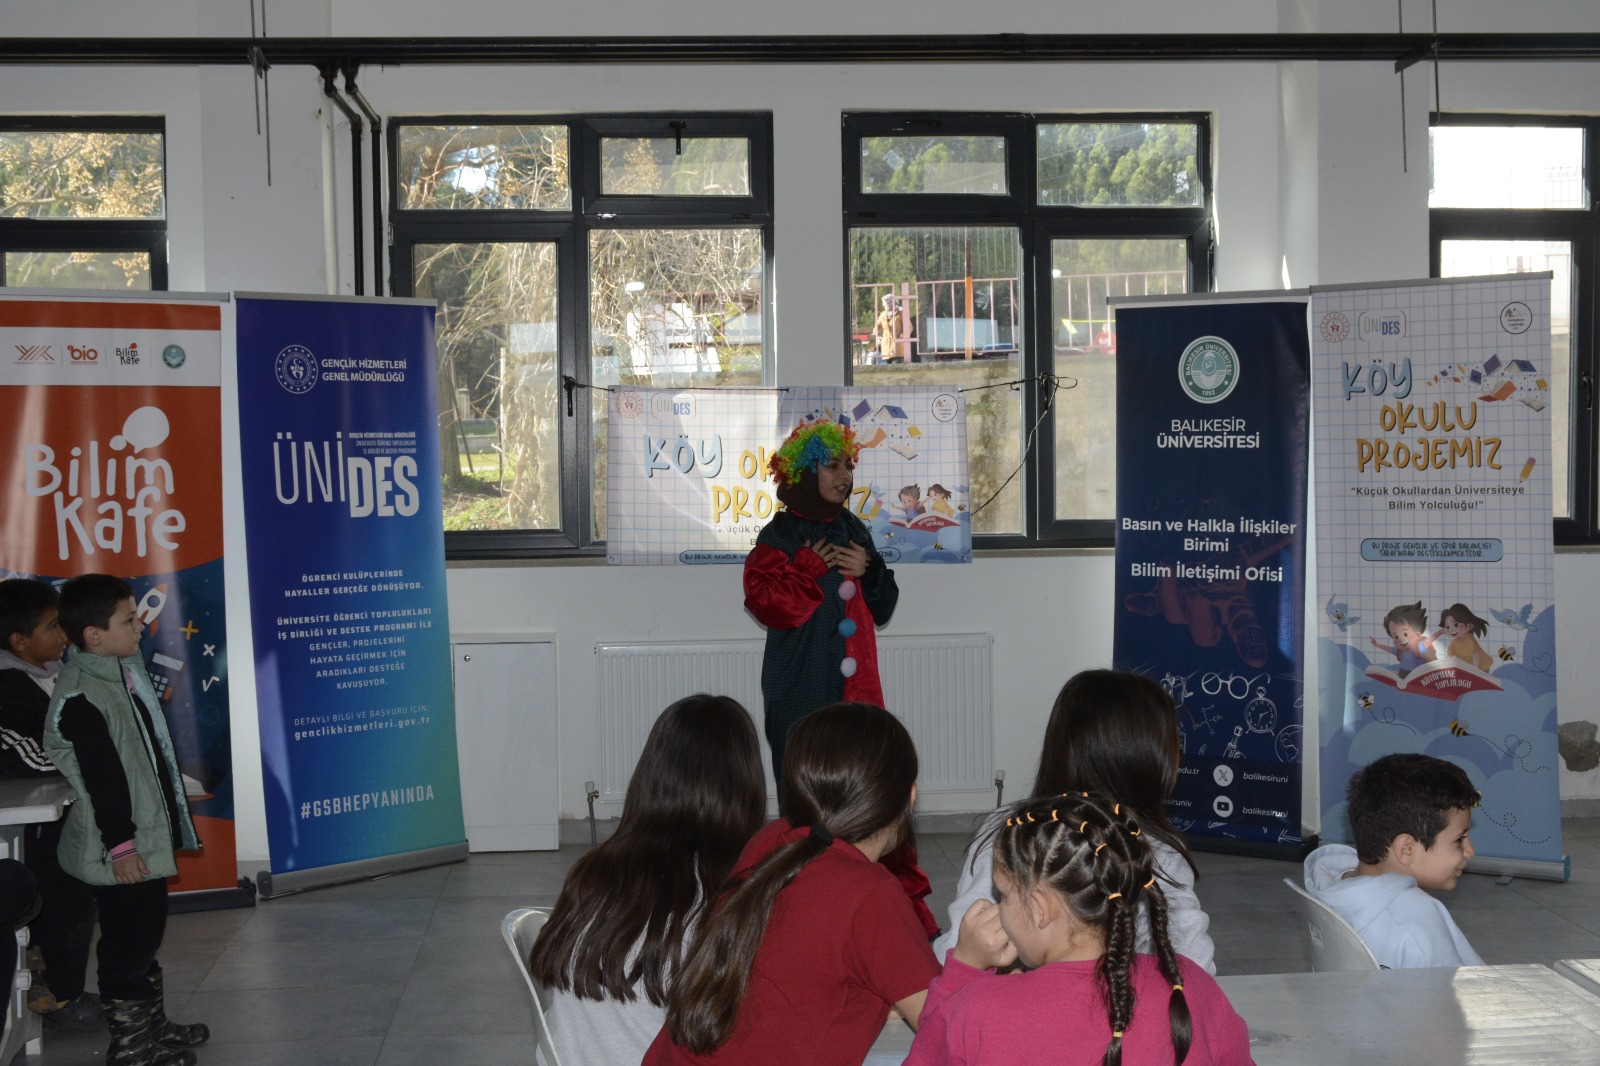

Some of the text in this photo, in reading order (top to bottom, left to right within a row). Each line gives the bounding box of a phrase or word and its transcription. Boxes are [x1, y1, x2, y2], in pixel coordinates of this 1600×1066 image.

[116, 348, 138, 357] Bilim
[321, 357, 407, 370] GENÇLİK HİZMETLERİ
[322, 371, 405, 382] GENEL MÜDÜRLÜĞÜ
[1341, 356, 1413, 400] KÖY
[1171, 416, 1246, 432] BALIKESİR
[1379, 400, 1477, 434] OKULU
[1157, 432, 1260, 448] ÜNİVERSİTESİ
[644, 434, 722, 478] KÖY
[1356, 436, 1502, 473] PROJEMİZ
[25, 440, 175, 500] Bilim
[1351, 485, 1525, 498] "Küçük Okullardan Üniversiteye
[1389, 500, 1484, 511] Bilim Yolculuğu!"
[54, 486, 186, 560] Kafe
[1122, 517, 1297, 537] Basın ve Halkla İlişkiler
[1184, 538, 1229, 552] Birimi
[343, 570, 404, 580] KULÜPLERİNDE
[1131, 562, 1283, 583] Bilim İletişimi Ofisi
[285, 587, 330, 598] HAYALLER
[333, 584, 368, 594] GERÇEĞE
[277, 607, 432, 626] ÜNİVERSİTE ÖĞRENCİ TOPLULUKLARI
[277, 619, 432, 640] İŞ BİRLİĞİ VE DESTEK PROGRAMI İLE
[353, 636, 405, 647] PROJELERİNİ
[310, 649, 406, 665] HAYATA GEÇİRMEK İÇİN
[316, 662, 406, 678] ARADIKLARI DESTEĞE
[294, 715, 330, 726] DETAYLI
[333, 712, 354, 723] BİLGİ
[357, 711, 366, 719] VE
[369, 707, 408, 718] BAŞVURU
[294, 716, 431, 741] genclikhizmetleri.gov.tr
[1243, 772, 1289, 784] balikesiruni
[300, 784, 434, 820] #GSBHEPYANINDA
[1243, 806, 1289, 818] balikesiruni
